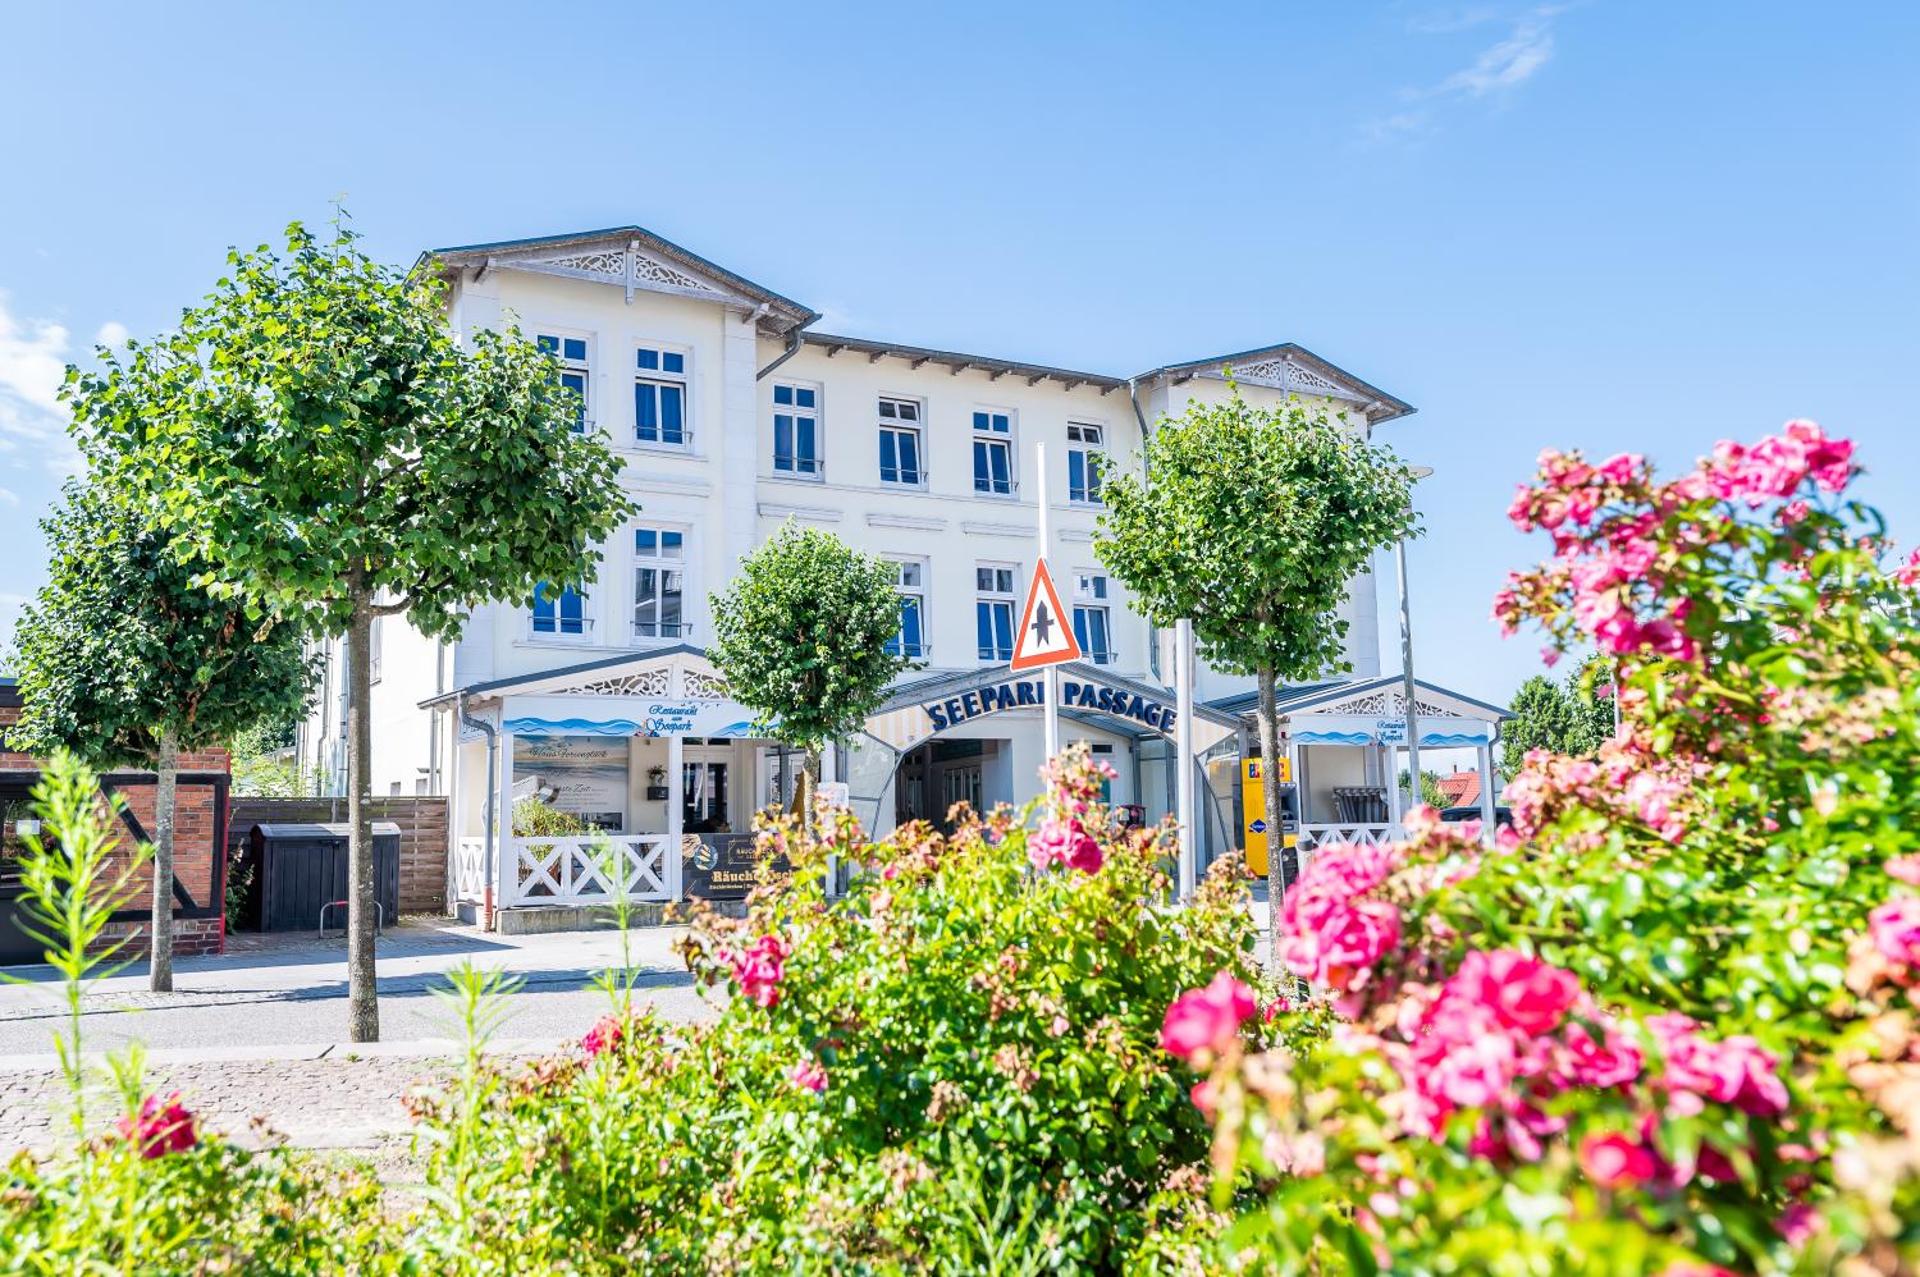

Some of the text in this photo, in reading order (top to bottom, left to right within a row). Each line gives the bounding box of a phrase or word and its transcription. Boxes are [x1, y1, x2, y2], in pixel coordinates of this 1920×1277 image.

[648, 705, 697, 715] Restaurant
[1064, 682, 1177, 734] PASSAGE
[646, 718, 692, 734] Seepark
